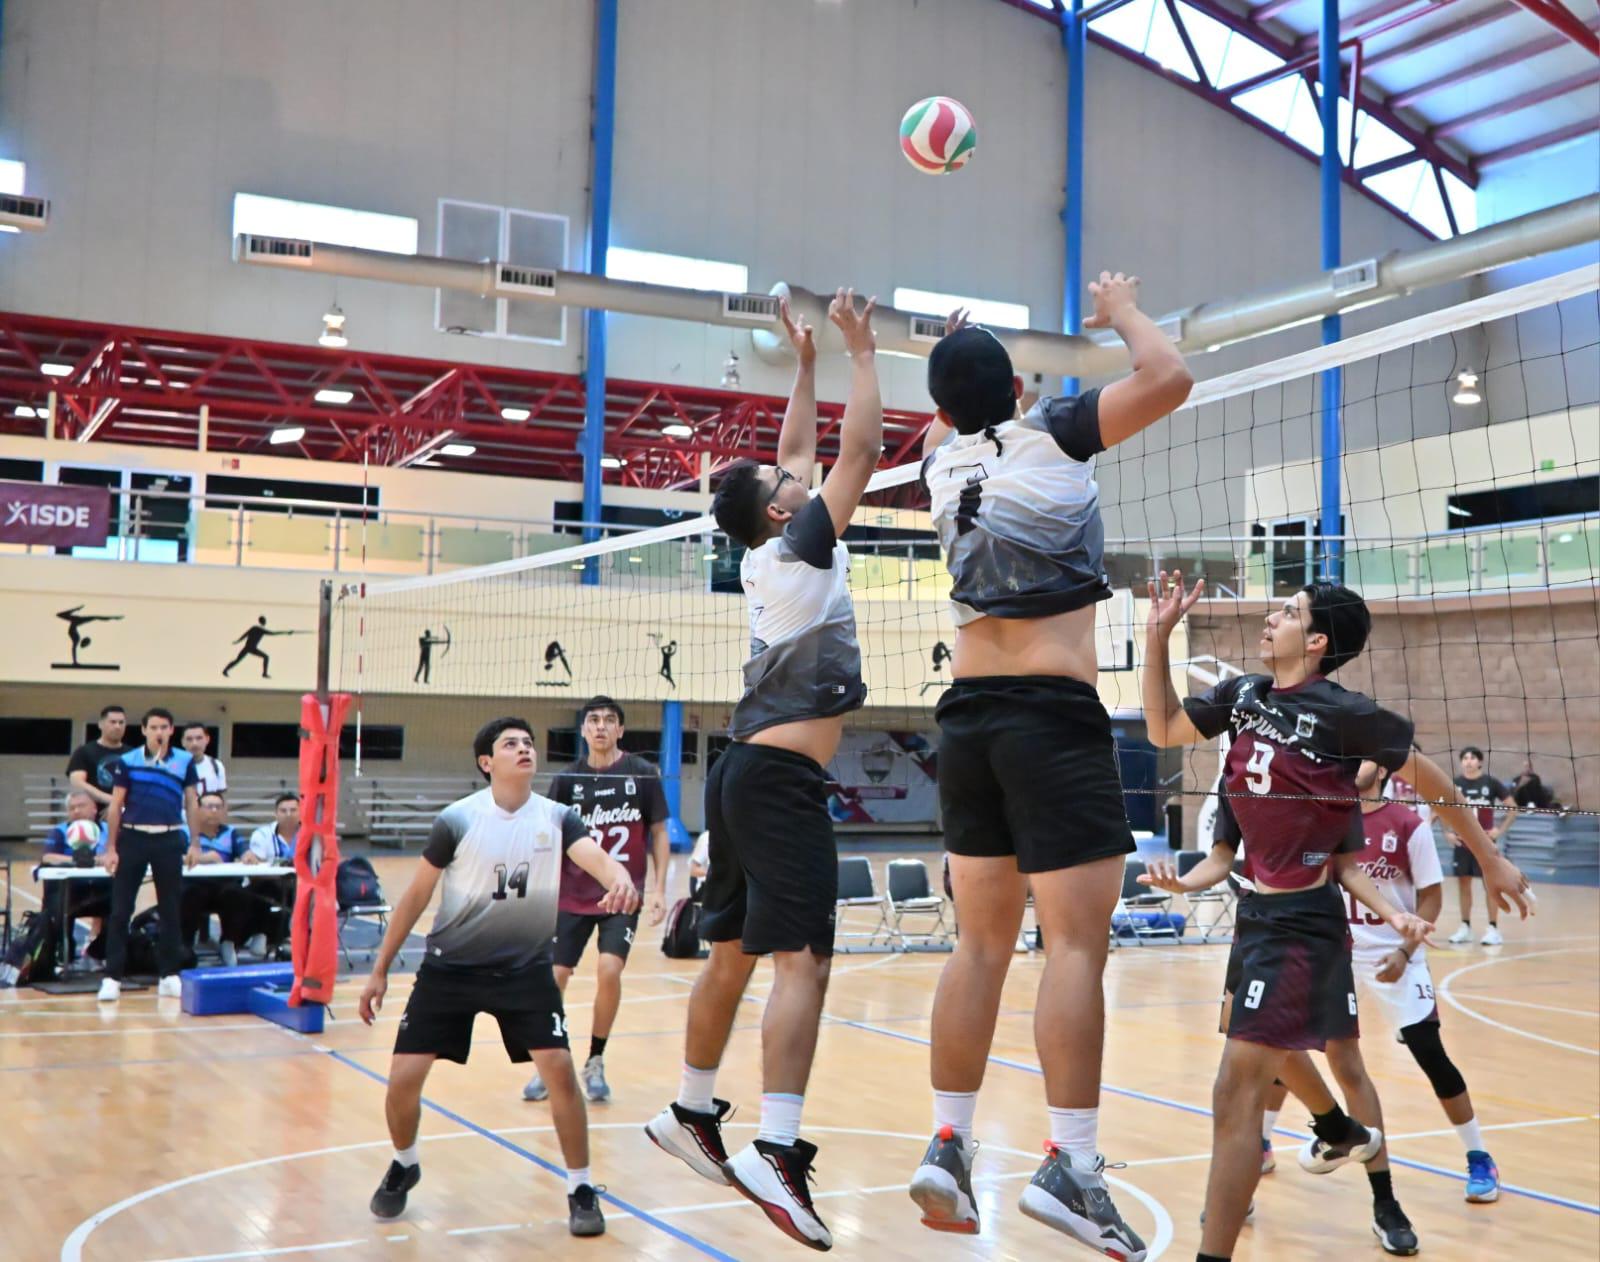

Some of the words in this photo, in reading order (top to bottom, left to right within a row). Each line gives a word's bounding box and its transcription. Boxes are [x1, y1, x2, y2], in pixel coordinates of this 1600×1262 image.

[31, 504, 90, 528] ISDE
[1244, 741, 1276, 795] 9
[492, 862, 530, 900] 14
[1244, 979, 1266, 1010] 9
